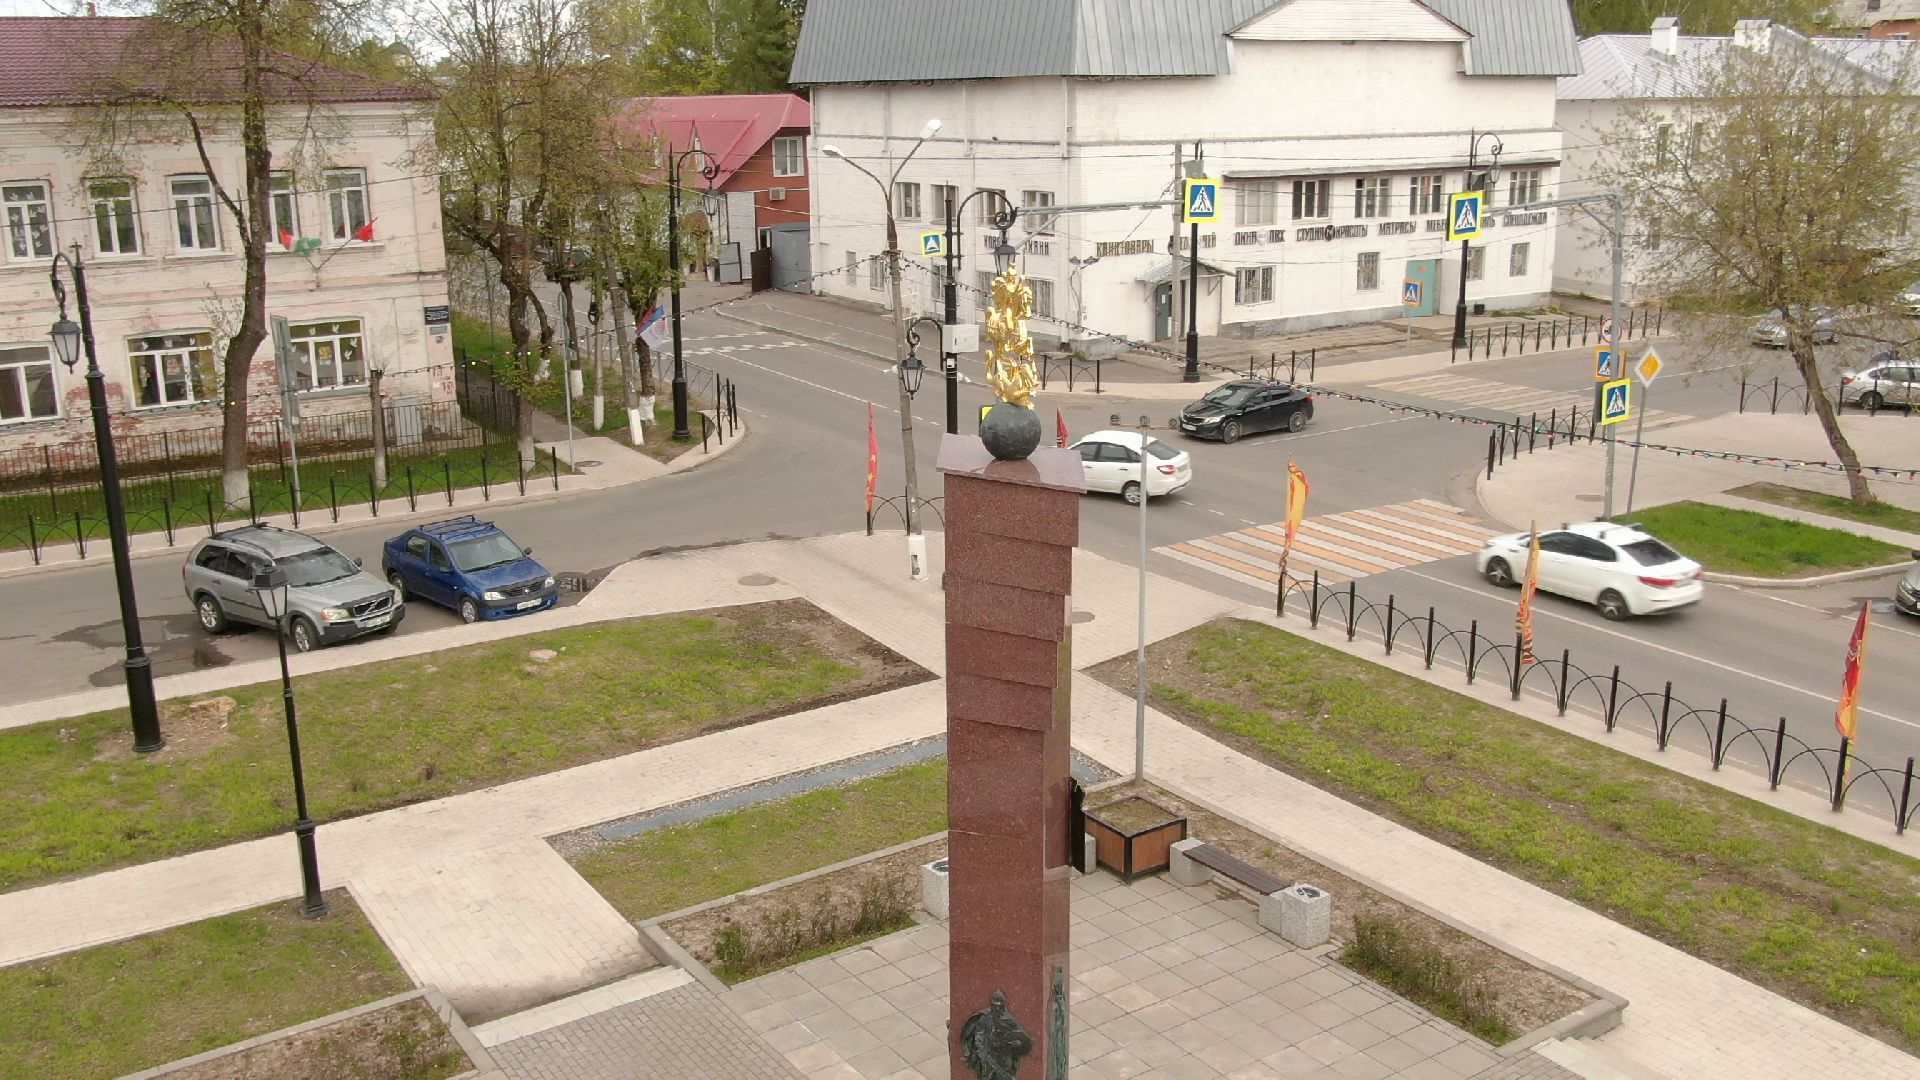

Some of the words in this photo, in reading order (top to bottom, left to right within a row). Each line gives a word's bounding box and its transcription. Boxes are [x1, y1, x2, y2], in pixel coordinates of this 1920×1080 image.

[1378, 221, 1417, 236] МАТРАСЫ
[1235, 231, 1257, 246] ОКНА
[1269, 229, 1286, 243] ПВХ
